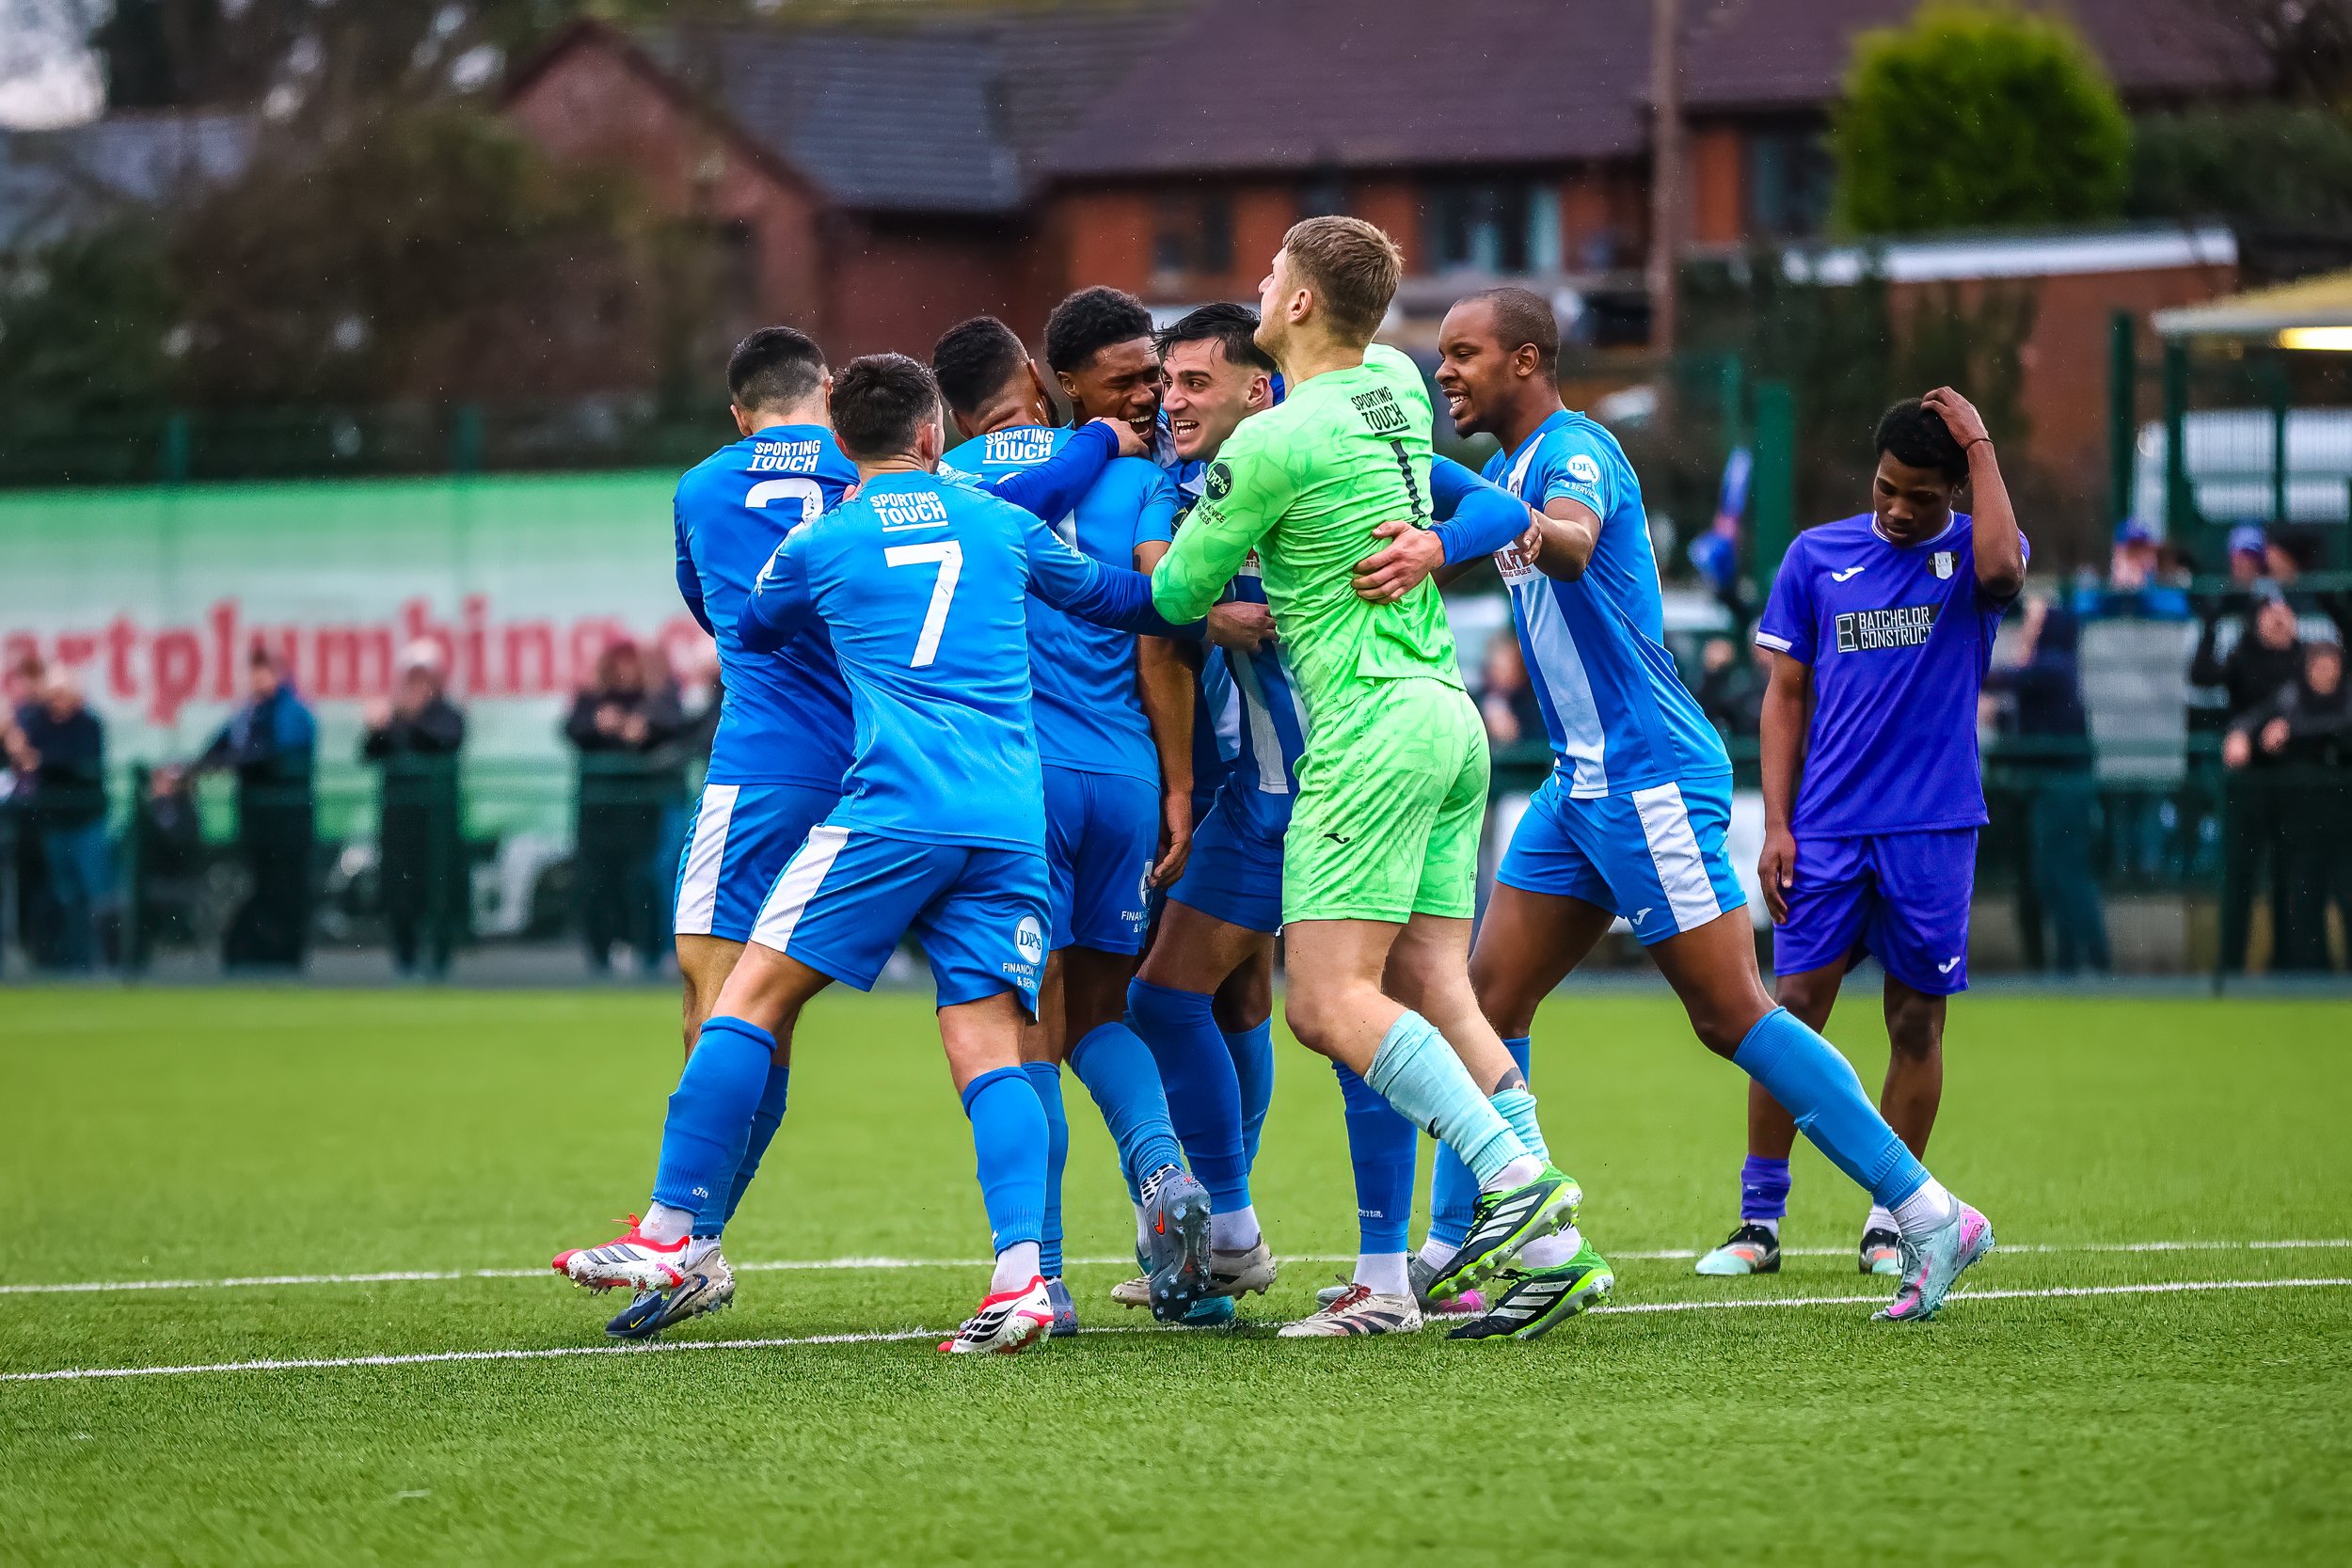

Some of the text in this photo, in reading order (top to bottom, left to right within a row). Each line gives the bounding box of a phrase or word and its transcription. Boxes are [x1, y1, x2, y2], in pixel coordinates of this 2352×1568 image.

[1351, 386, 1393, 411] SPORTING
[1361, 403, 1407, 431] TOUCH
[755, 439, 821, 456] SPORTING
[985, 428, 1055, 446] SPORTING
[984, 440, 1053, 461] TOUCH
[750, 454, 819, 472] TOUCH
[869, 491, 940, 508] SPORTING
[873, 500, 947, 527] TOUCH
[883, 539, 964, 669] 7
[1858, 606, 1930, 630] BATCHELOR
